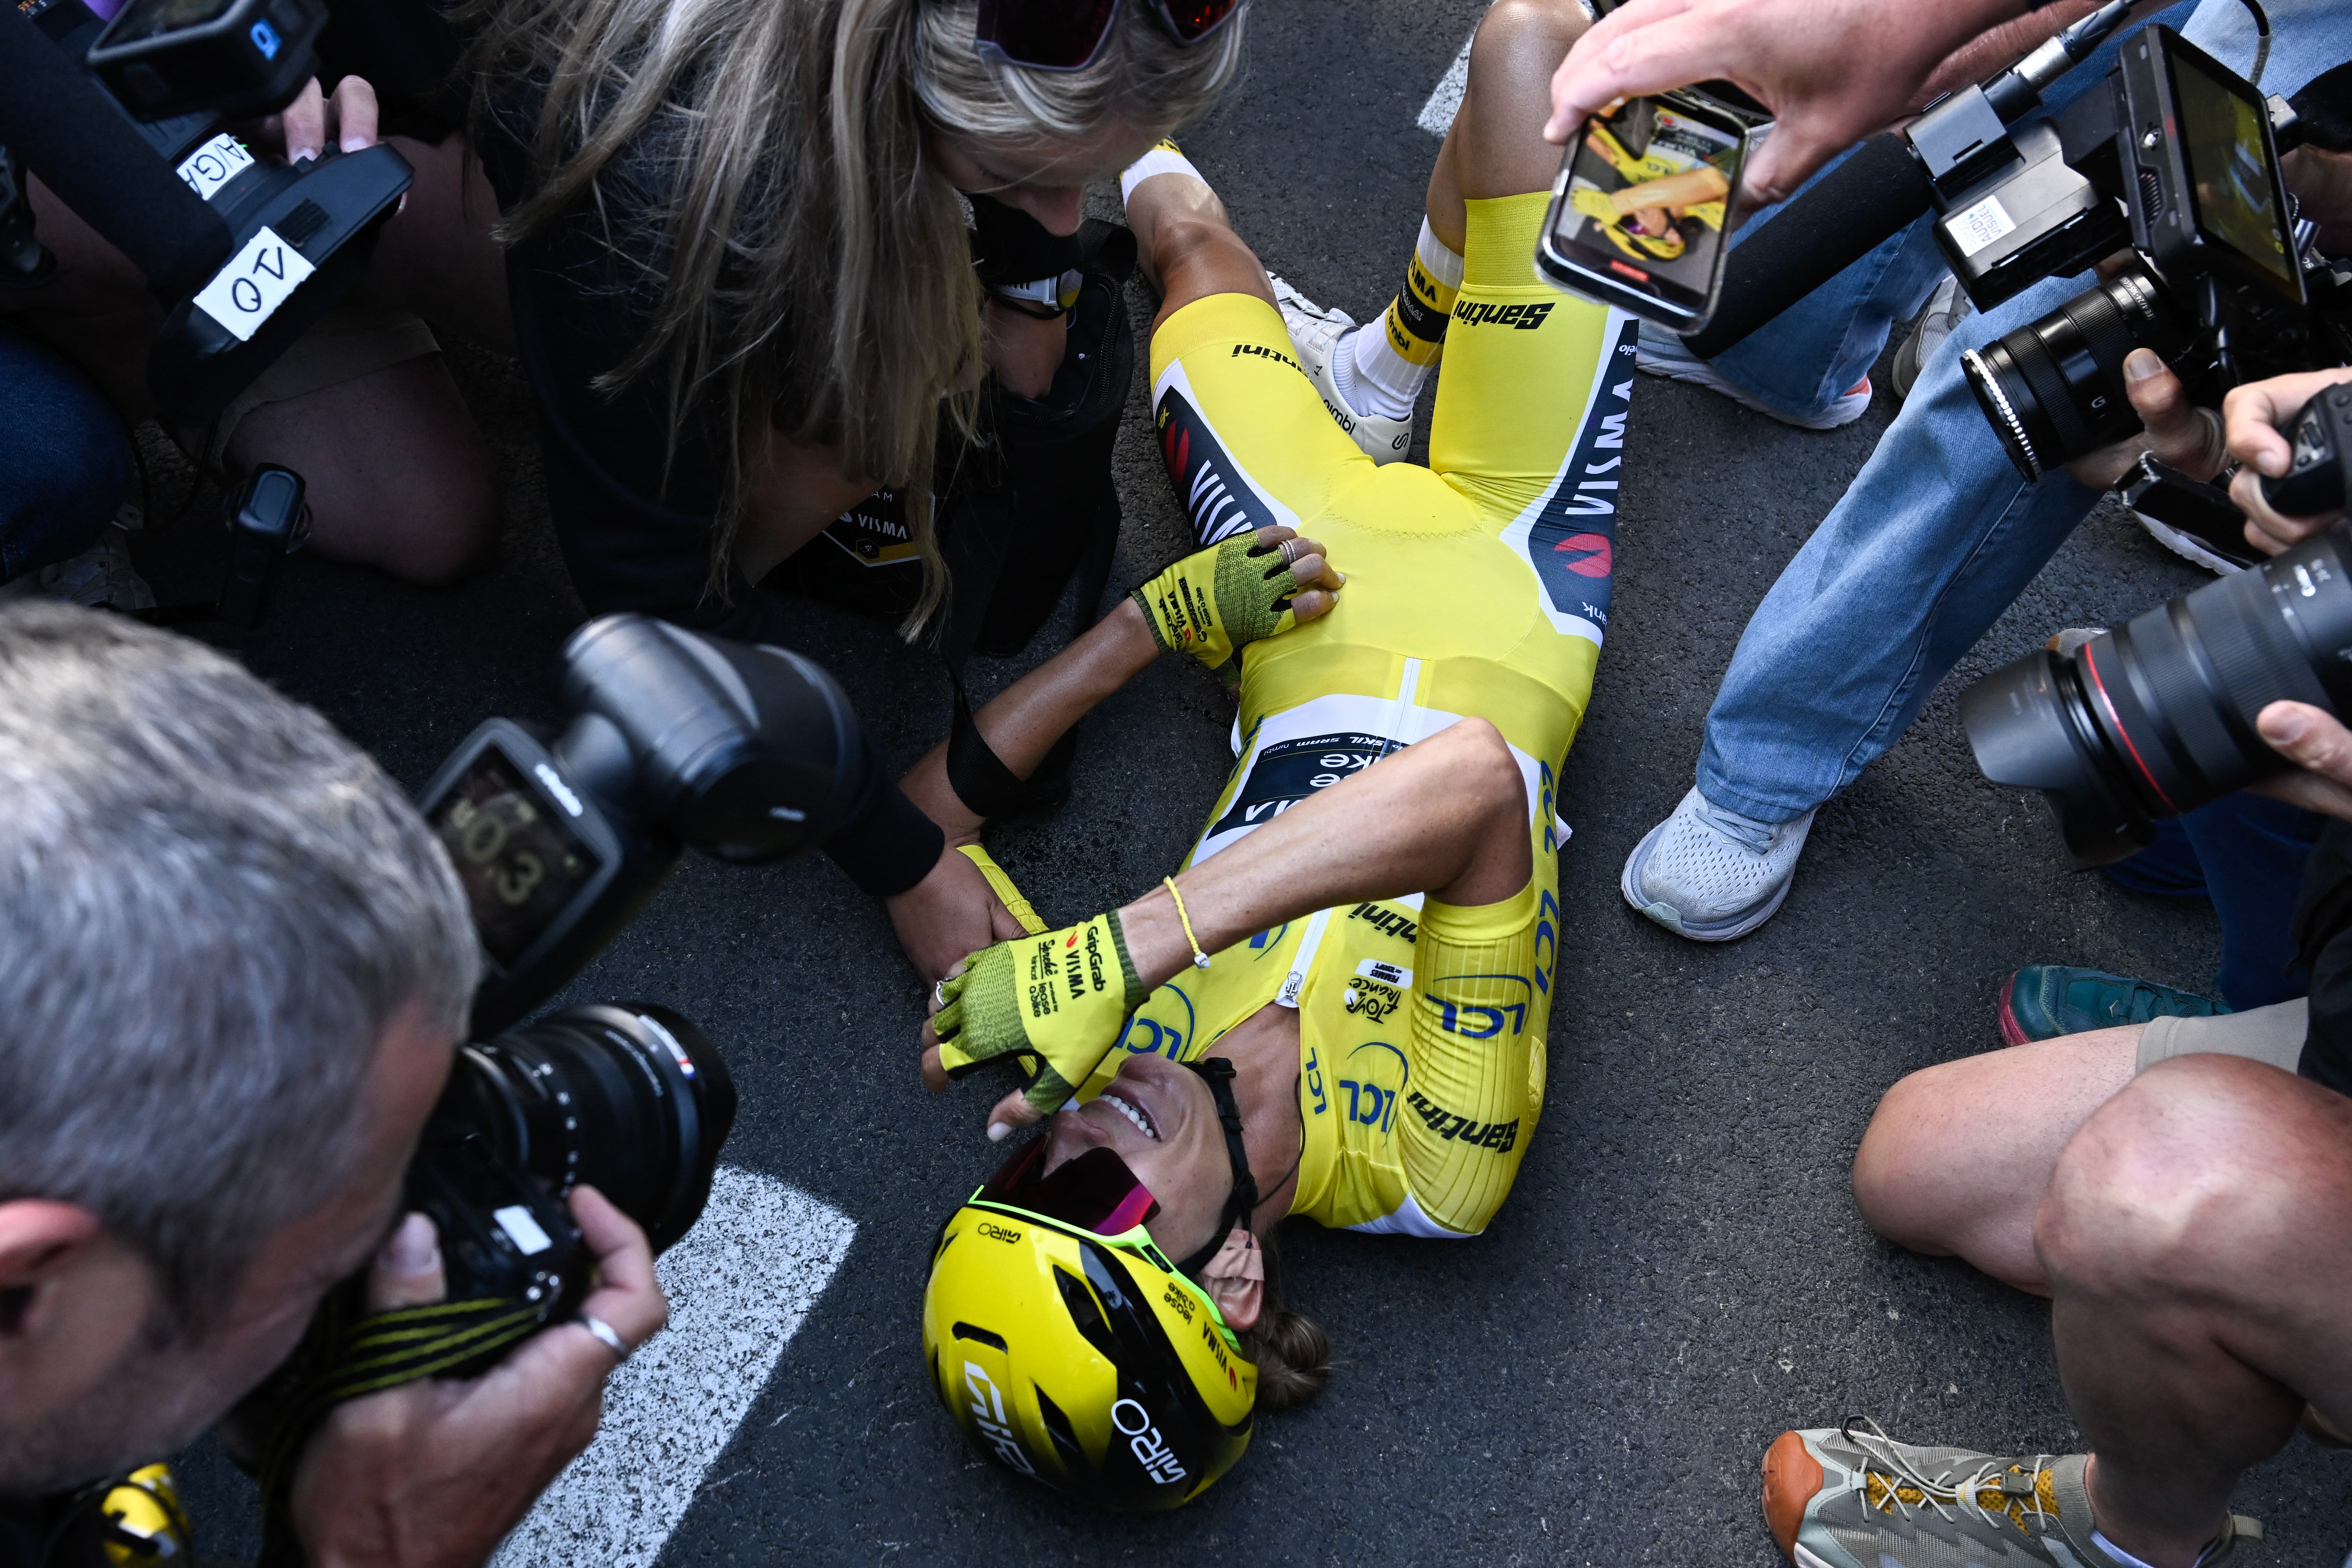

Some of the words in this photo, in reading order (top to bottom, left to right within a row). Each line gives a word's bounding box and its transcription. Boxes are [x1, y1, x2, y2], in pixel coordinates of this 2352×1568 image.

[1977, 204, 2002, 238] VISUEL
[232, 246, 284, 313] 10
[1453, 299, 1556, 329] Santini
[1323, 399, 1357, 435] nimbl
[2089, 396, 2106, 410] G
[1565, 378, 1633, 515] VISMA
[857, 512, 908, 539] VISMA
[1159, 598, 1183, 643] GripGrab
[1168, 590, 1187, 628] VISMA
[1203, 608, 1213, 627] lease
[1263, 743, 1290, 756] nimbl
[1296, 737, 1340, 747] SRAM
[1349, 736, 1385, 747] SKIL
[1348, 902, 1418, 945] ntini
[1066, 949, 1085, 1000] VISMA
[1085, 926, 1106, 992] GripGrab
[1029, 986, 1036, 994] a
[1370, 969, 1400, 984] FEMMES
[1039, 982, 1051, 1015] lease
[1425, 993, 1526, 1039] LCL
[1305, 1047, 1327, 1115] LCL
[1339, 1079, 1396, 1132] LCL
[1406, 1091, 1520, 1154] Santini
[977, 1222, 1021, 1245] GIRO
[1164, 1293, 1193, 1325] lease
[1168, 1282, 1188, 1308] bike
[1189, 1302, 1195, 1311] a
[1202, 1321, 1227, 1373] VISMA
[1110, 1398, 1187, 1485] GIRO
